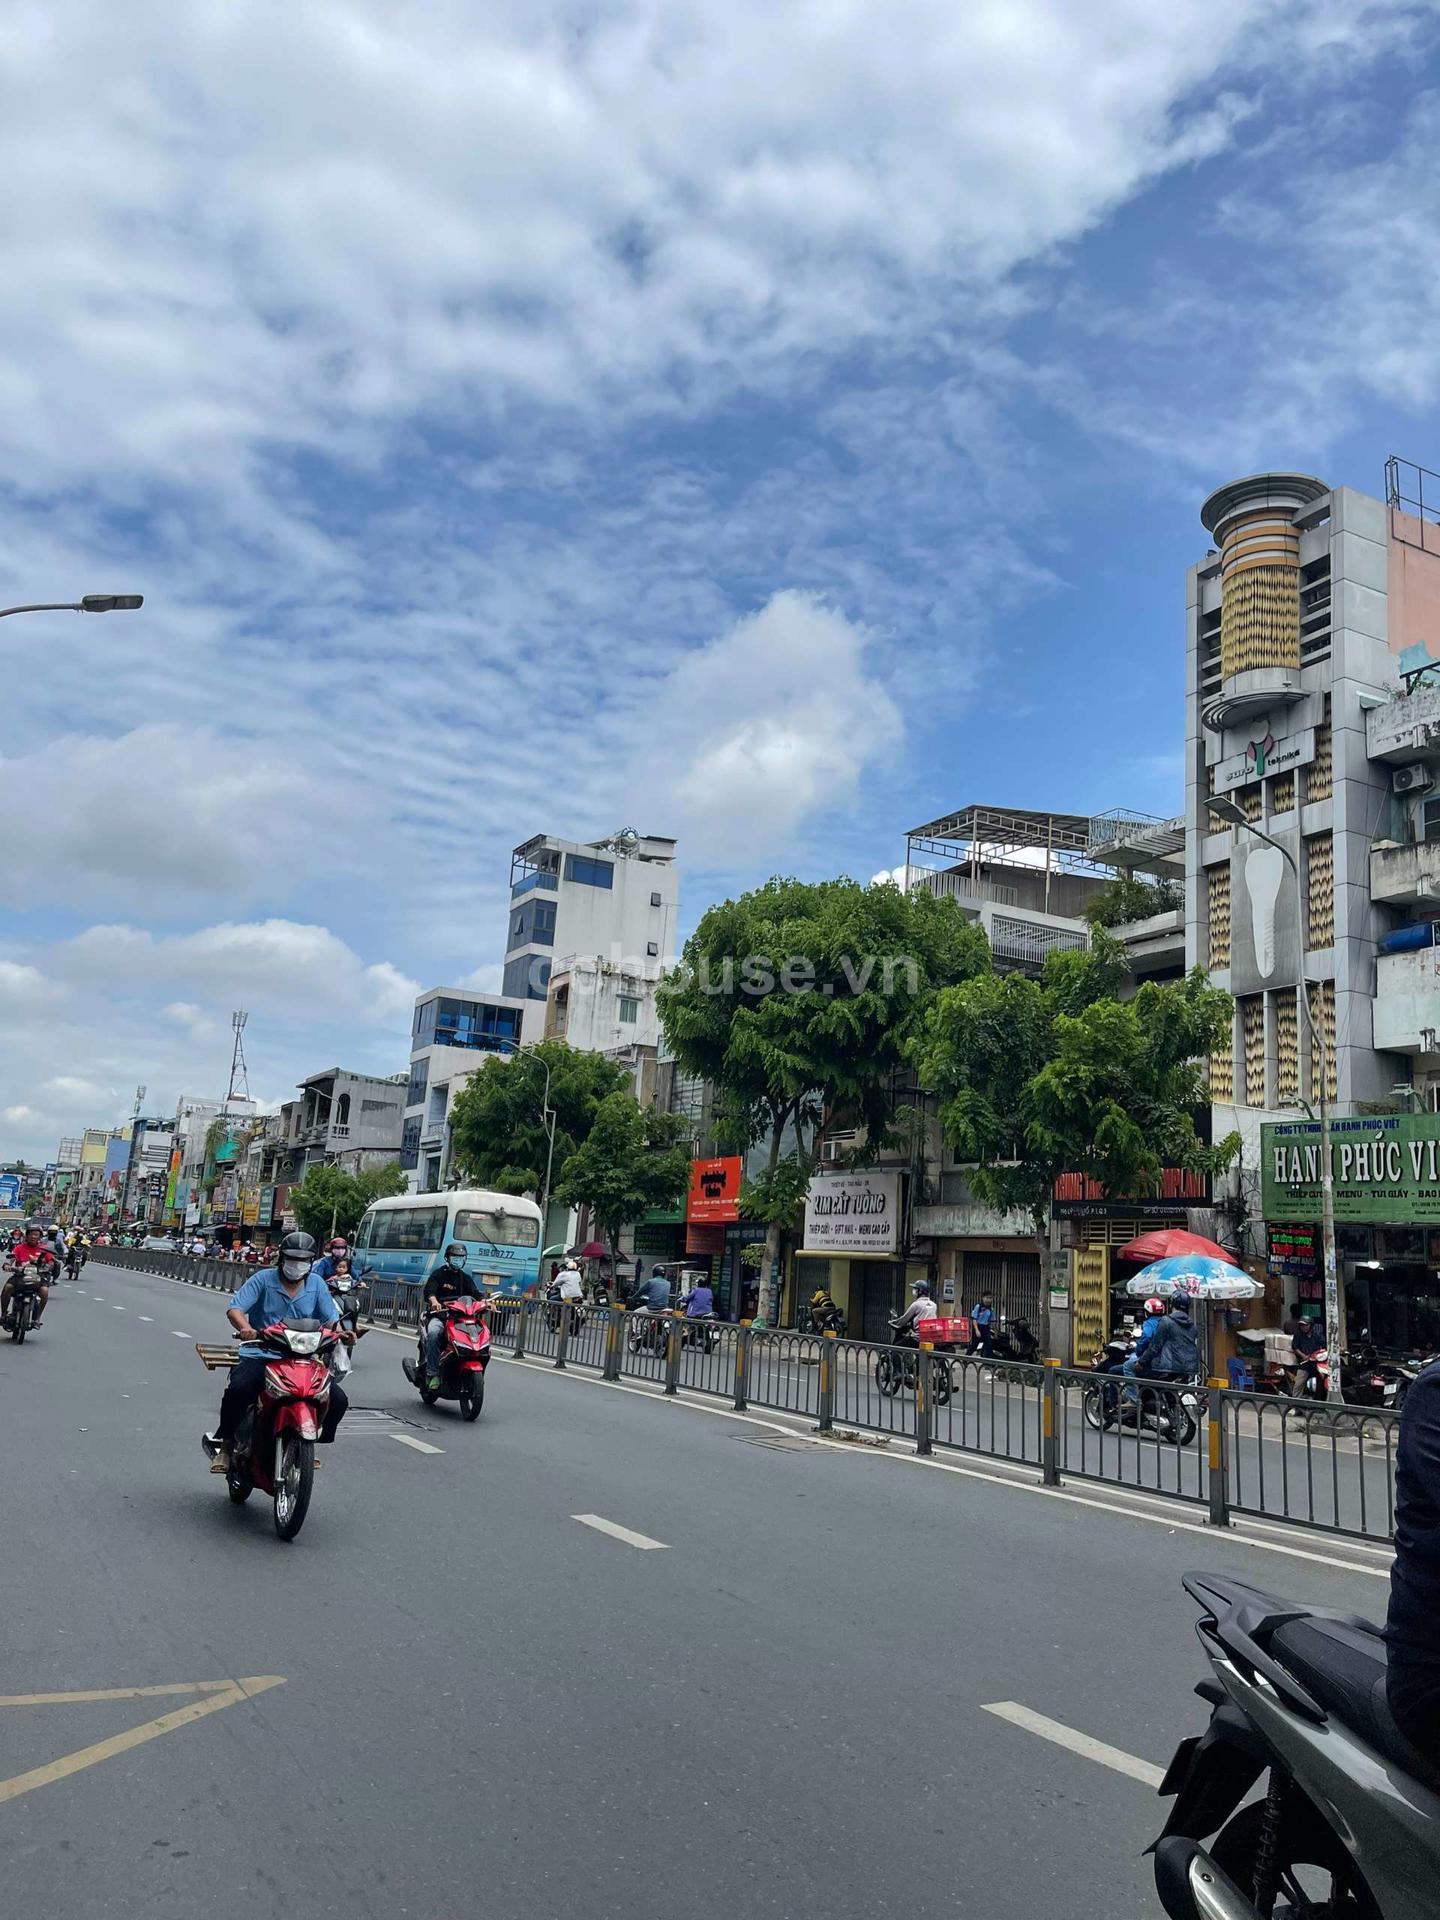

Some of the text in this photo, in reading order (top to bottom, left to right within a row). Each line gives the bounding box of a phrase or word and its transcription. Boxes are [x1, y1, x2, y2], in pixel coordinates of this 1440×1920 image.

[1267, 749, 1300, 766] teknika
[1274, 1124, 1293, 1135] CÔNG
[1362, 1118, 1382, 1130] PHÚC
[1340, 1131, 1401, 1182] PHÚC
[1408, 1140, 1440, 1182] VI
[814, 1188, 886, 1215] KIM CÁT TƯỜNG
[1336, 1190, 1362, 1198] MENU
